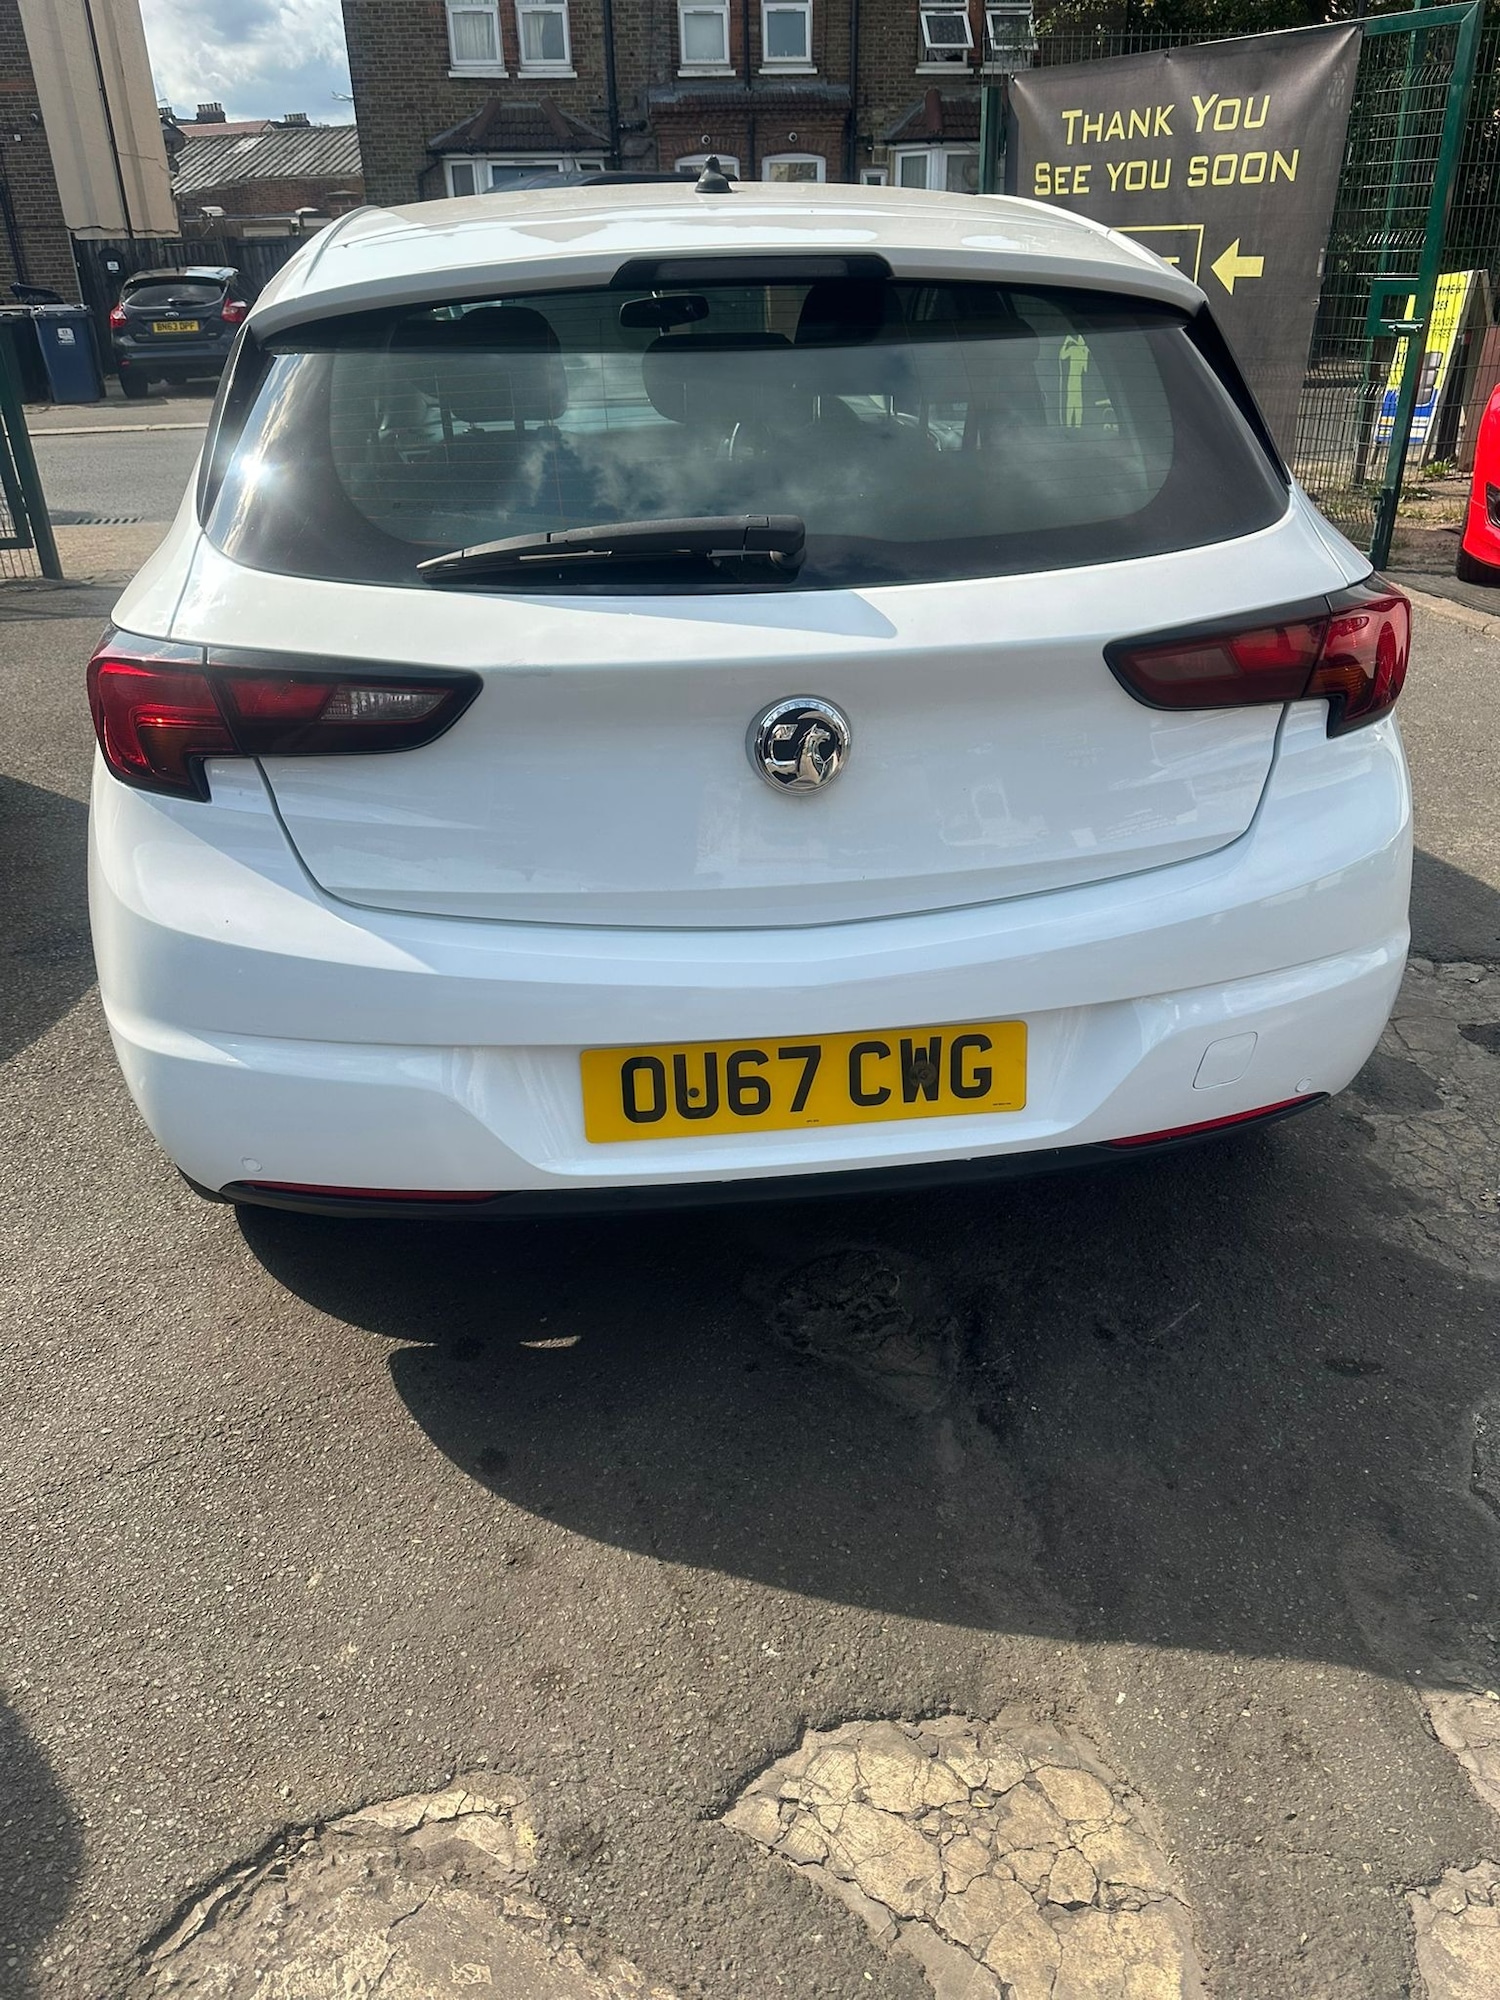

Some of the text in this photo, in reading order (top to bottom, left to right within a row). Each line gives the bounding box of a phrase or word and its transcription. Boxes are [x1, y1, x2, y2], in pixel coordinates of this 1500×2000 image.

[1061, 93, 1271, 146] THANK YOU
[1033, 148, 1300, 196] SEE YOU SOON
[156, 322, 178, 331] BN63
[620, 1033, 993, 1124] OU67 CWG
